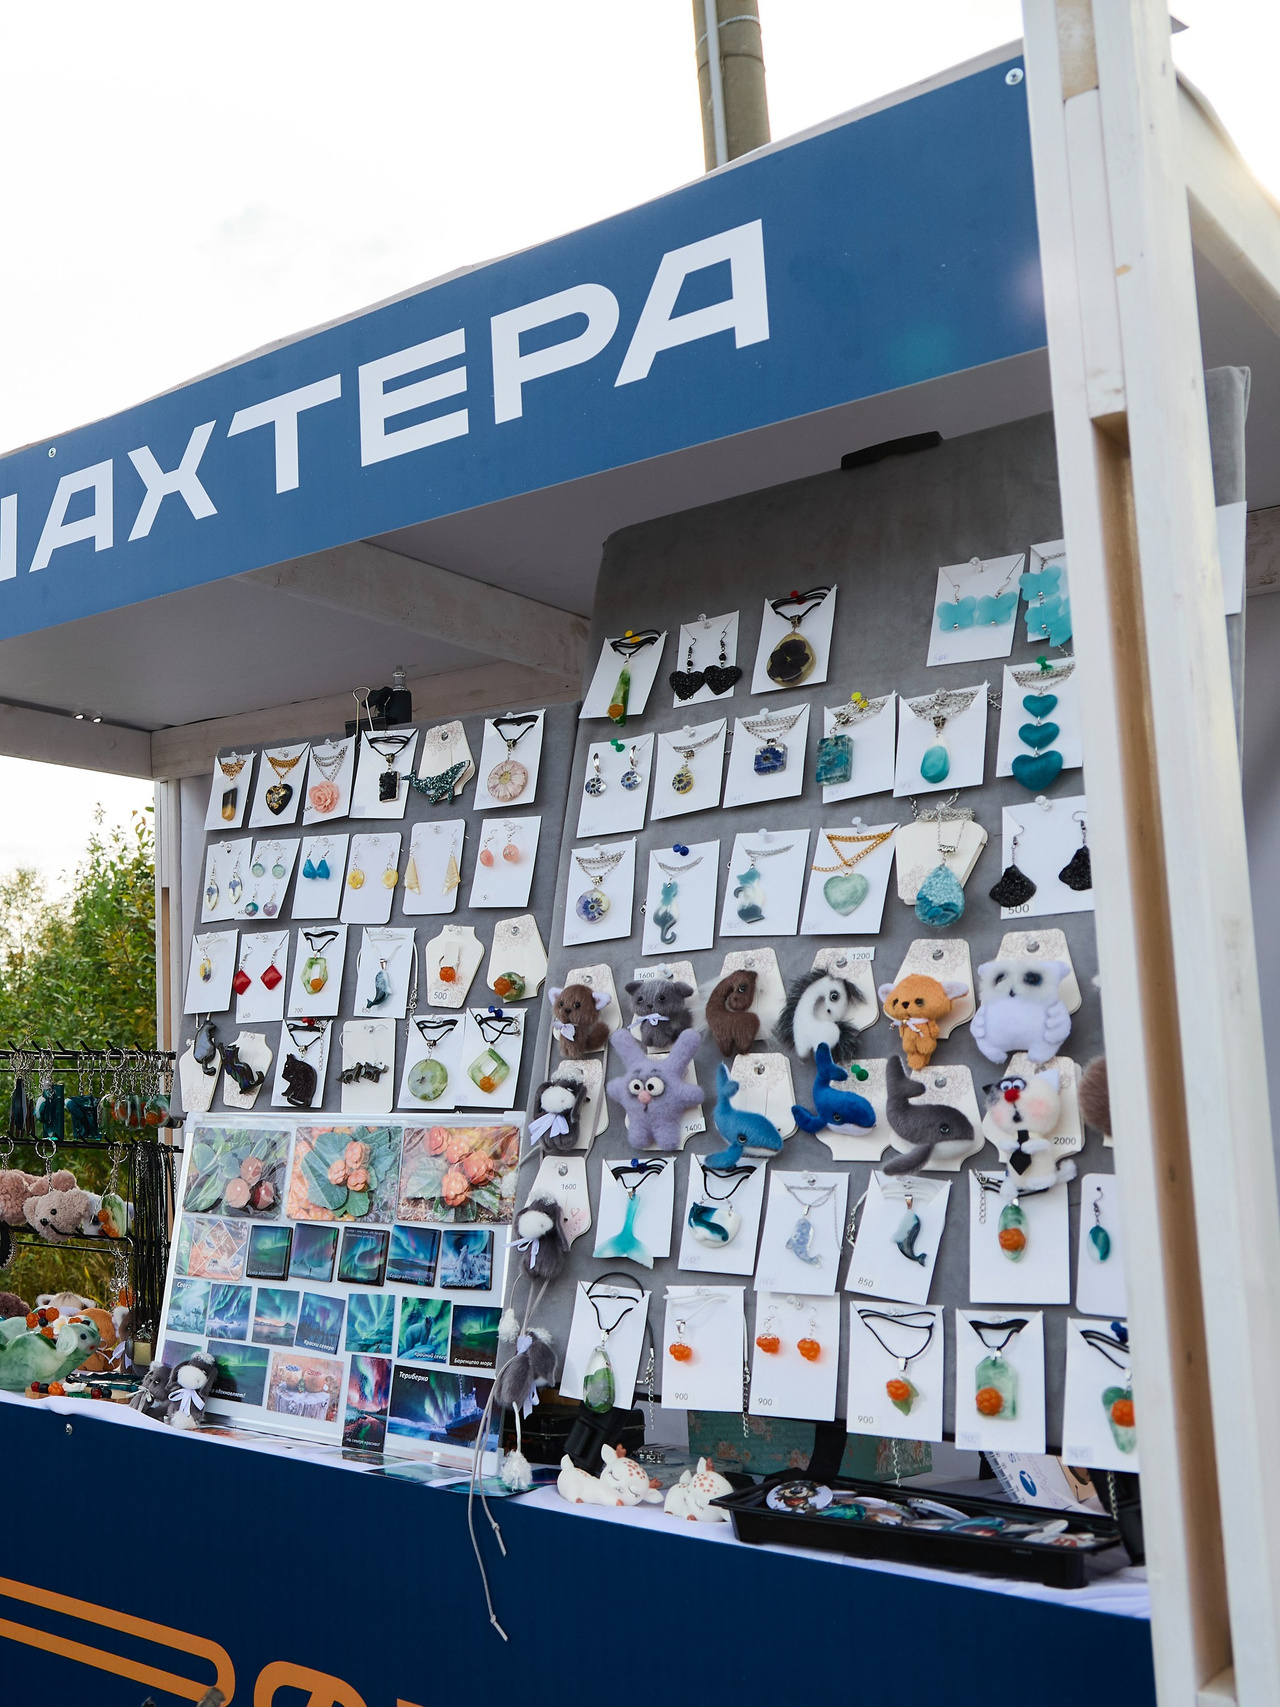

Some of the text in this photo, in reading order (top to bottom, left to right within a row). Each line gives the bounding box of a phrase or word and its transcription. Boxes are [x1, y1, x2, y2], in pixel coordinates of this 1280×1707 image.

[1008, 904, 1030, 915] 500
[638, 971, 655, 979] 1600
[433, 991, 448, 1001] 500
[685, 1123, 703, 1132] 1400
[1053, 1136, 1077, 1146] 2000
[561, 1183, 577, 1191] 1600
[857, 1277, 873, 1288] 850
[399, 1371, 429, 1382] Териберка
[674, 1392, 690, 1401] 900
[757, 1397, 773, 1406] 900
[857, 1414, 874, 1424] 900
